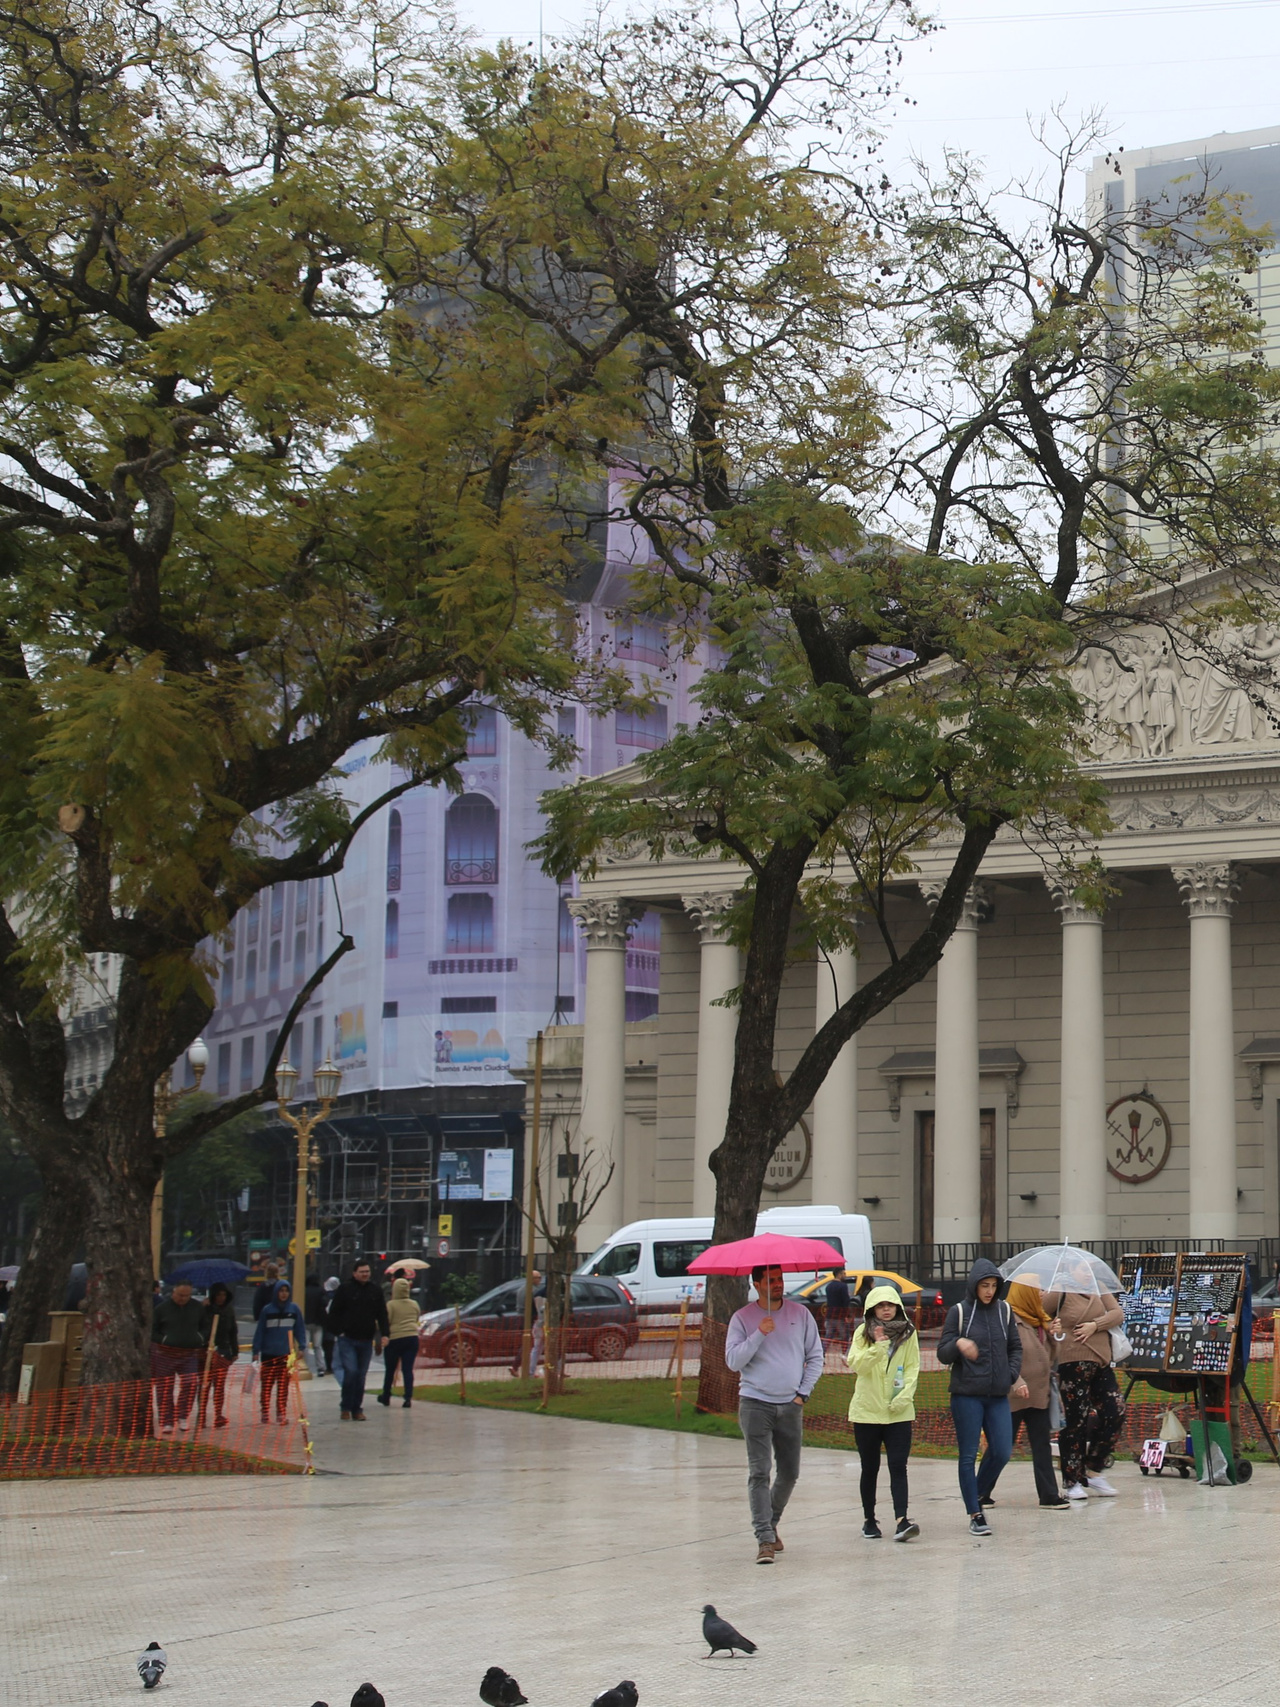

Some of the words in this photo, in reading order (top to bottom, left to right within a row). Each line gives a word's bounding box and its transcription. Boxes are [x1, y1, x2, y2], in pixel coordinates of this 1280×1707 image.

[484, 1063, 510, 1071] Ciudad
[773, 1151, 801, 1163] ULUM
[770, 1166, 793, 1177] UUM
